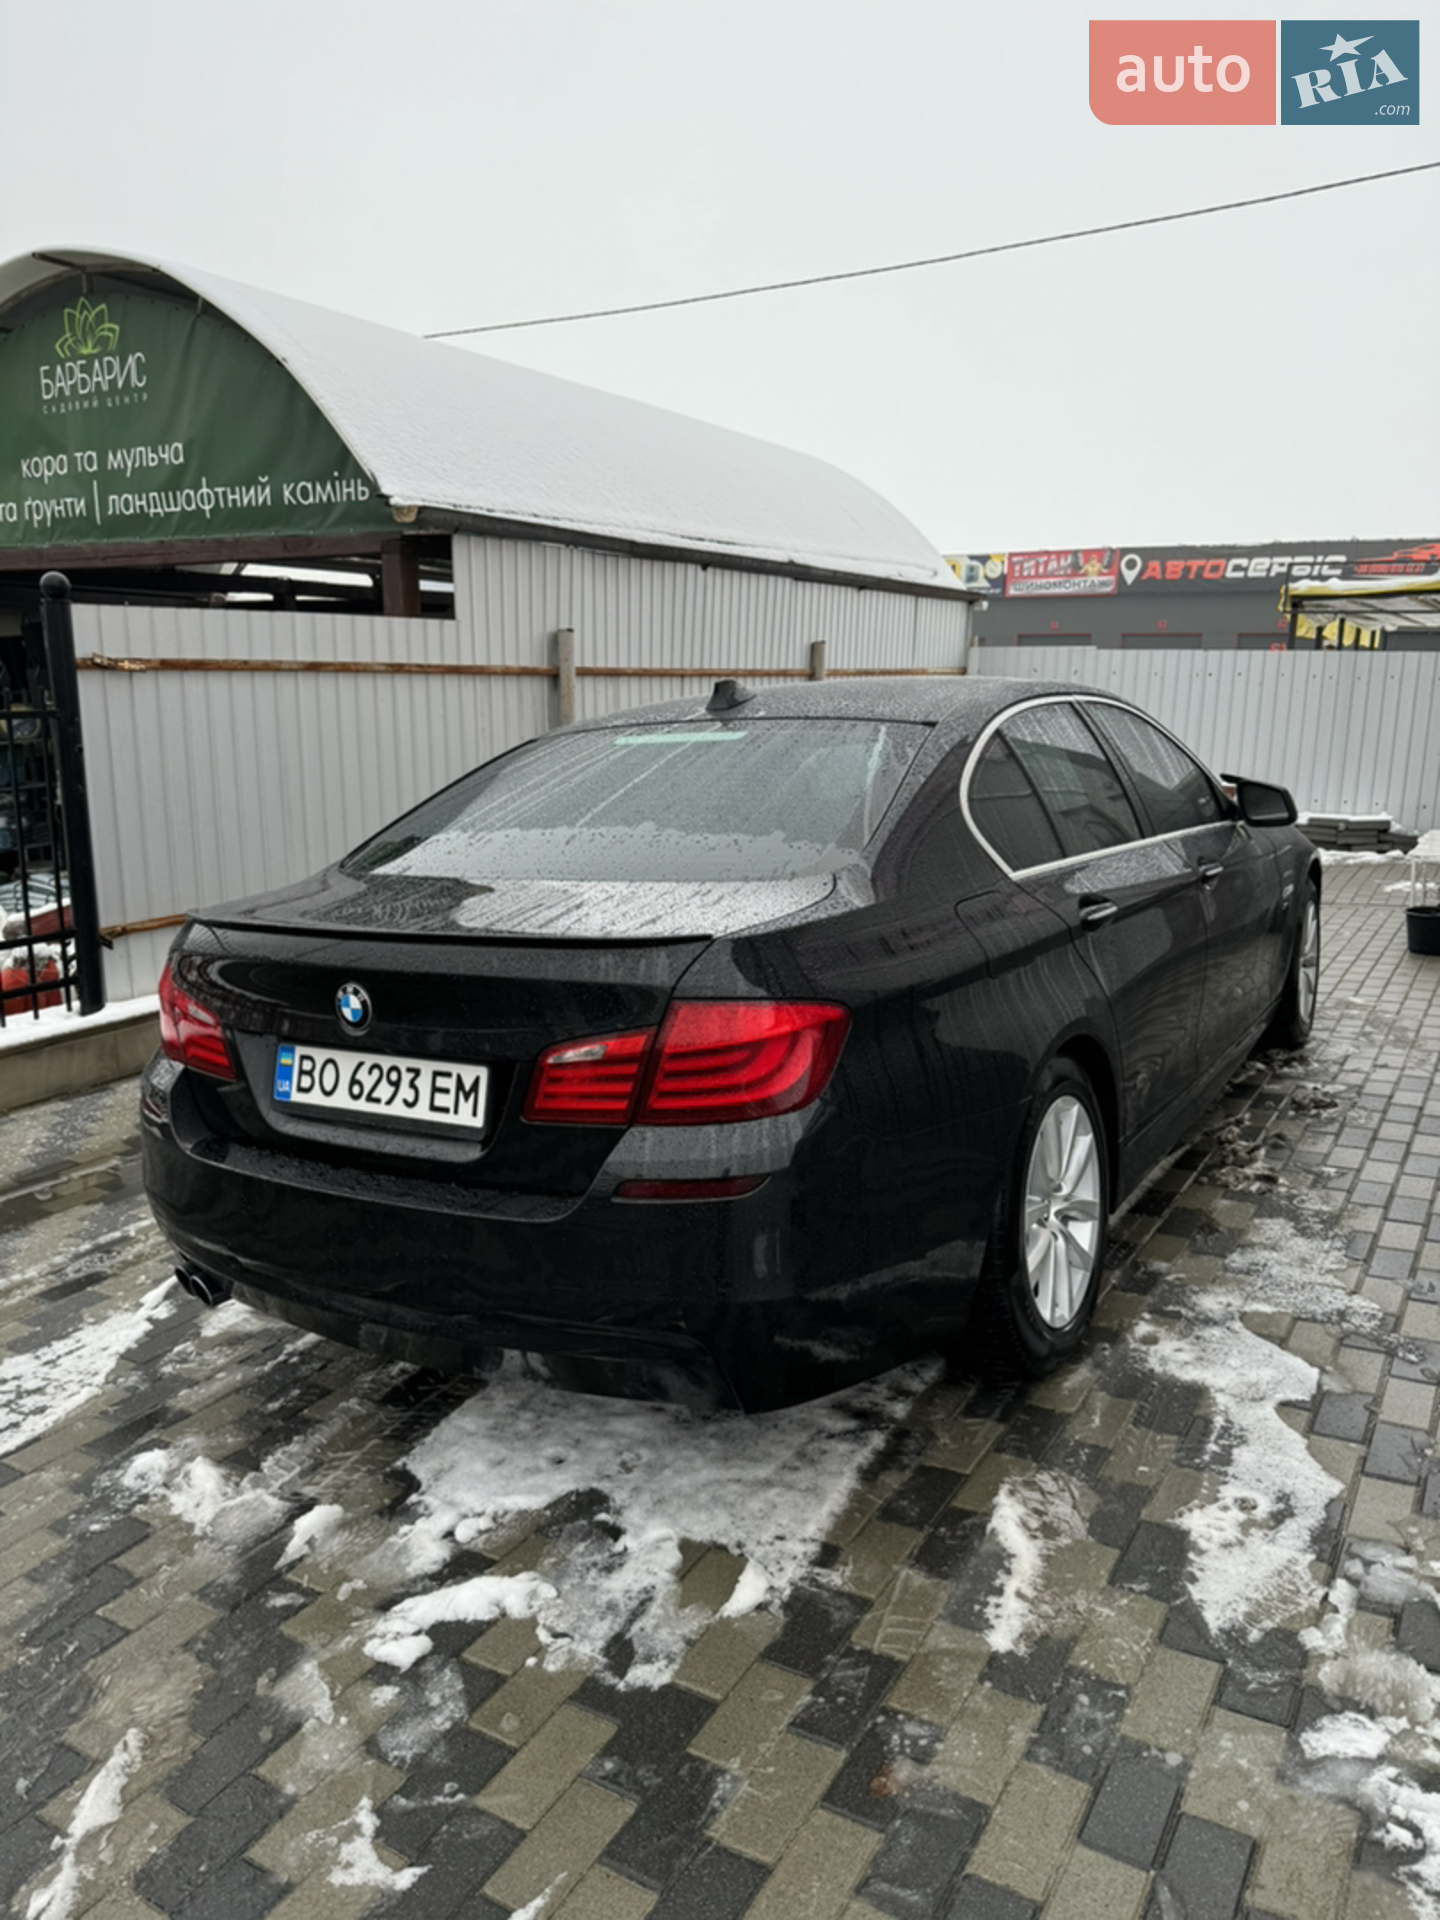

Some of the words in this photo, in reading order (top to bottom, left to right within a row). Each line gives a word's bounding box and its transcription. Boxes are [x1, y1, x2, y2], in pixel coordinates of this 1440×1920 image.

[39, 352, 147, 399] БАРБАРИС
[21, 454, 68, 484] кора
[74, 450, 98, 473] та
[107, 442, 184, 477] мульча
[24, 496, 87, 528] ґрунти
[107, 475, 271, 518] ландшафтний
[283, 471, 370, 506] камінь
[296, 1055, 340, 1097] BO
[348, 1061, 421, 1109] 6293
[428, 1070, 481, 1118] EM
